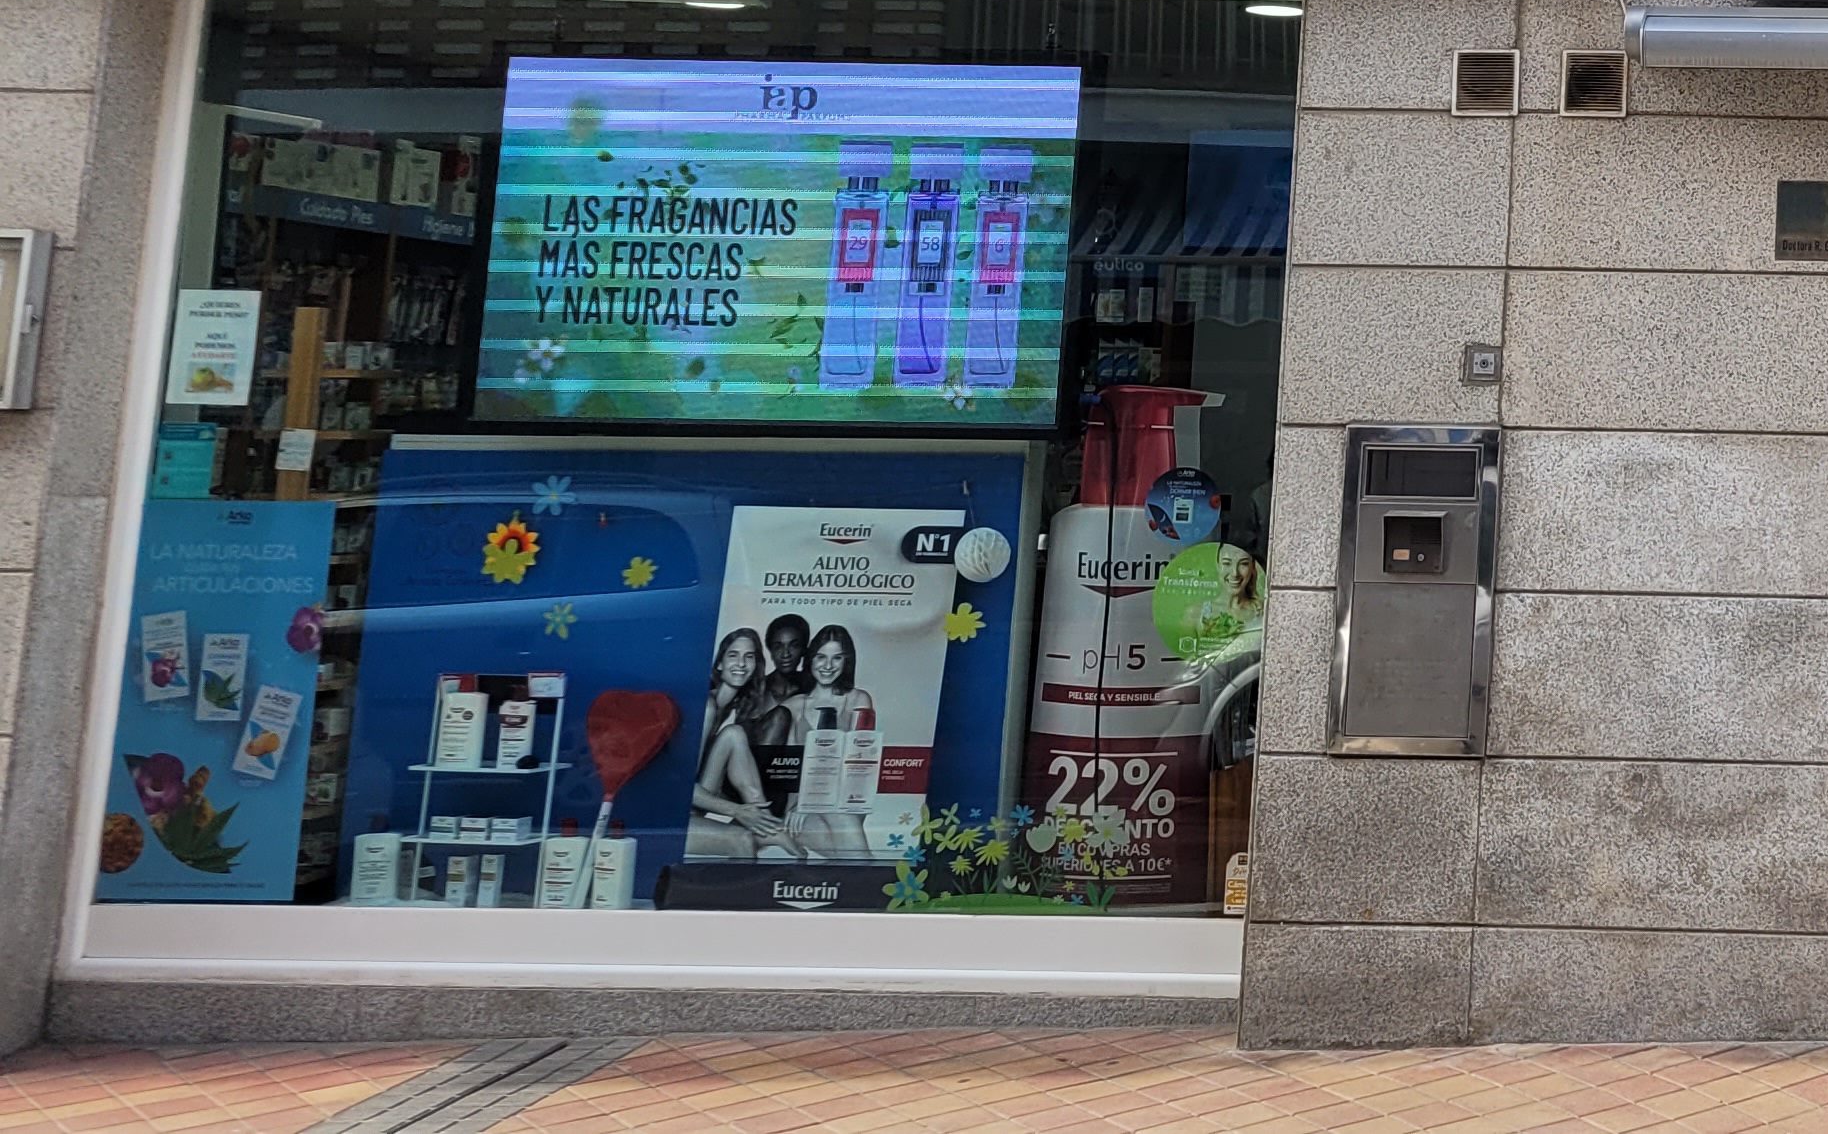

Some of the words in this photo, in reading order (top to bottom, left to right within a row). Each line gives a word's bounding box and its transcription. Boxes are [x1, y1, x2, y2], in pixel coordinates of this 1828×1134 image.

[542, 194, 601, 233] LAS
[608, 196, 799, 236] FRAGANCIAS
[849, 235, 868, 252] 29
[920, 236, 940, 252] 58
[1782, 239, 1812, 251] Doctora
[537, 229, 601, 280] MÁS
[608, 240, 745, 281] FRESCAS
[535, 285, 554, 324] Y
[561, 286, 739, 327] NATURALES
[819, 522, 873, 538] Eucerin
[150, 543, 173, 559] LA
[178, 543, 298, 560] NATURALEZA
[812, 555, 870, 571] ALIVIO
[151, 576, 315, 594] ARTICULACIONES
[763, 570, 915, 589] DERMATOLÓGICO
[1162, 575, 1219, 588] Transforma
[760, 597, 787, 606] PARA
[790, 597, 817, 606] TODO
[820, 598, 844, 606] TIPO
[847, 598, 859, 606] DE
[887, 599, 913, 607] SECA
[1068, 690, 1084, 700] PIEL
[1114, 693, 1161, 702] SENSIBLE
[771, 757, 800, 766] ALIVIO
[883, 758, 925, 767] CONFORT
[1045, 755, 1176, 817] 22%
[772, 880, 839, 901] Eucerin
